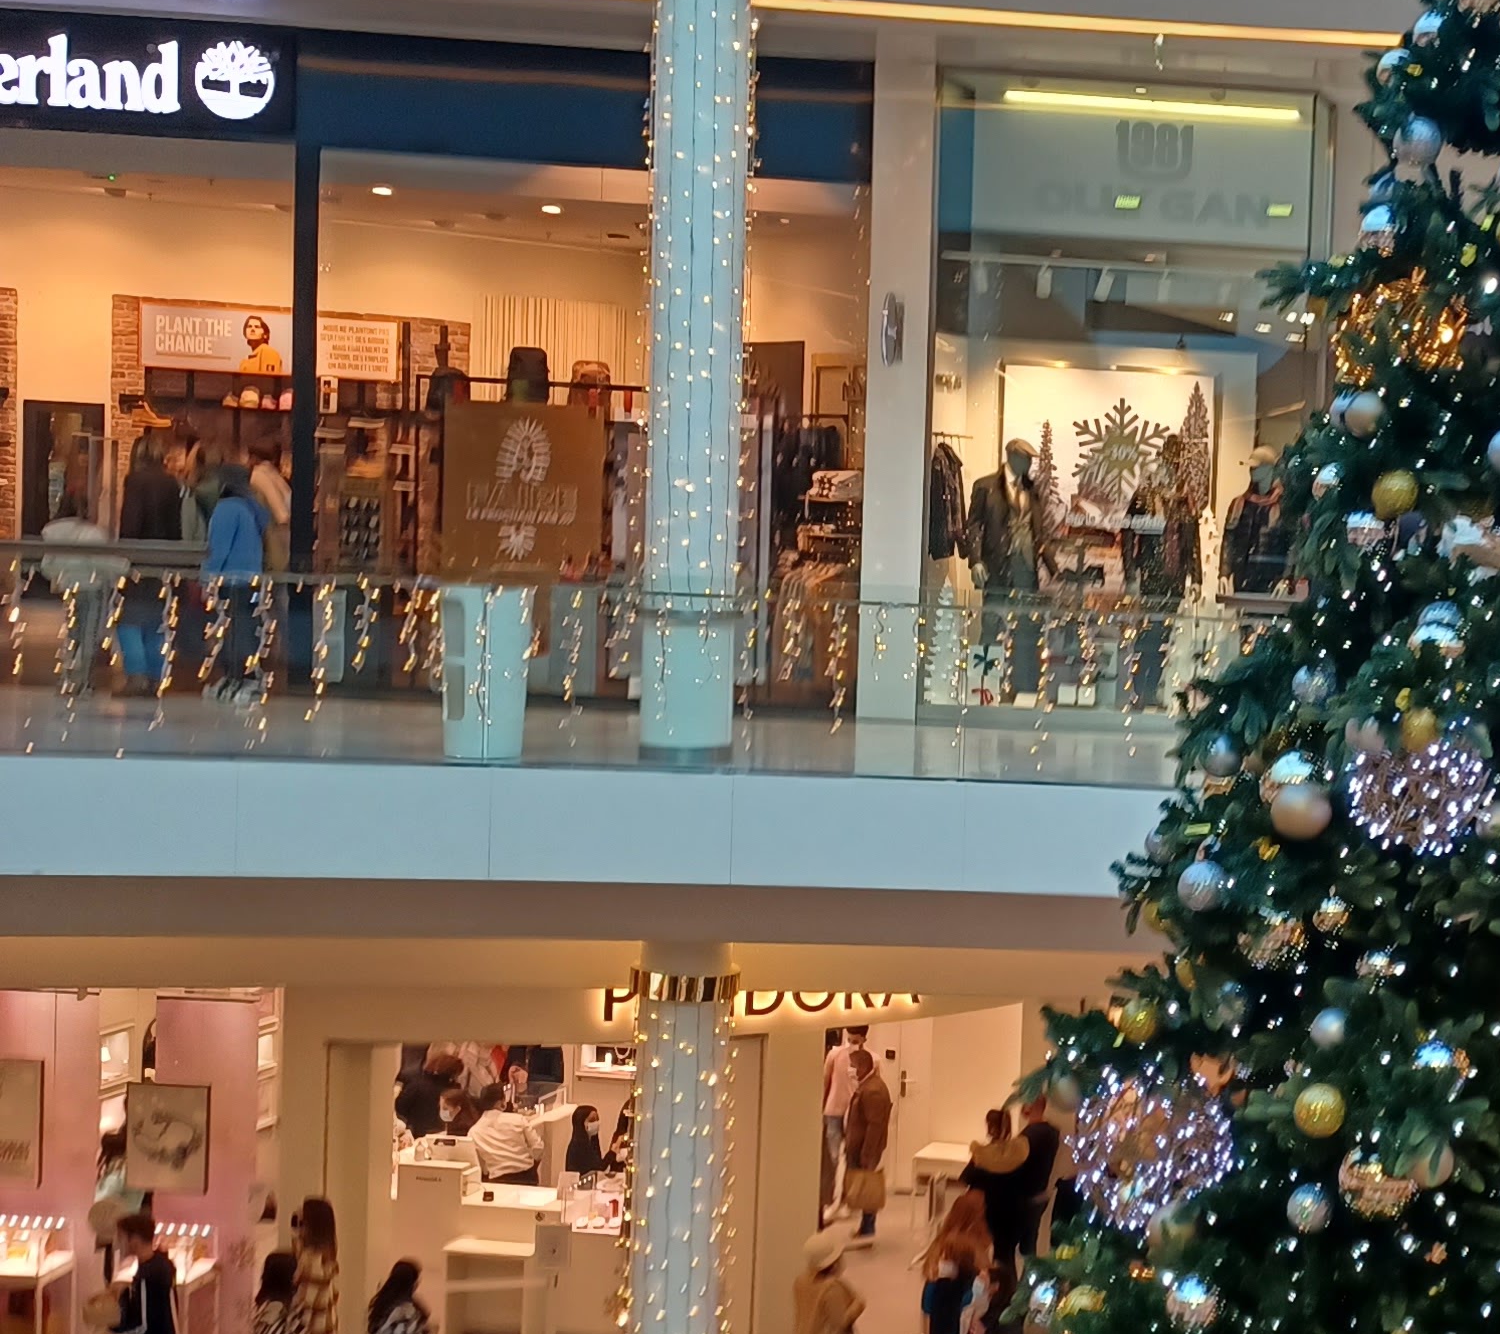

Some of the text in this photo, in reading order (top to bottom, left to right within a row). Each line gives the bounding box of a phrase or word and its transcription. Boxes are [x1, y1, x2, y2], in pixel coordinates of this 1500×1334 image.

[1115, 119, 1194, 175] 1981
[156, 315, 232, 337] PLANT THE
